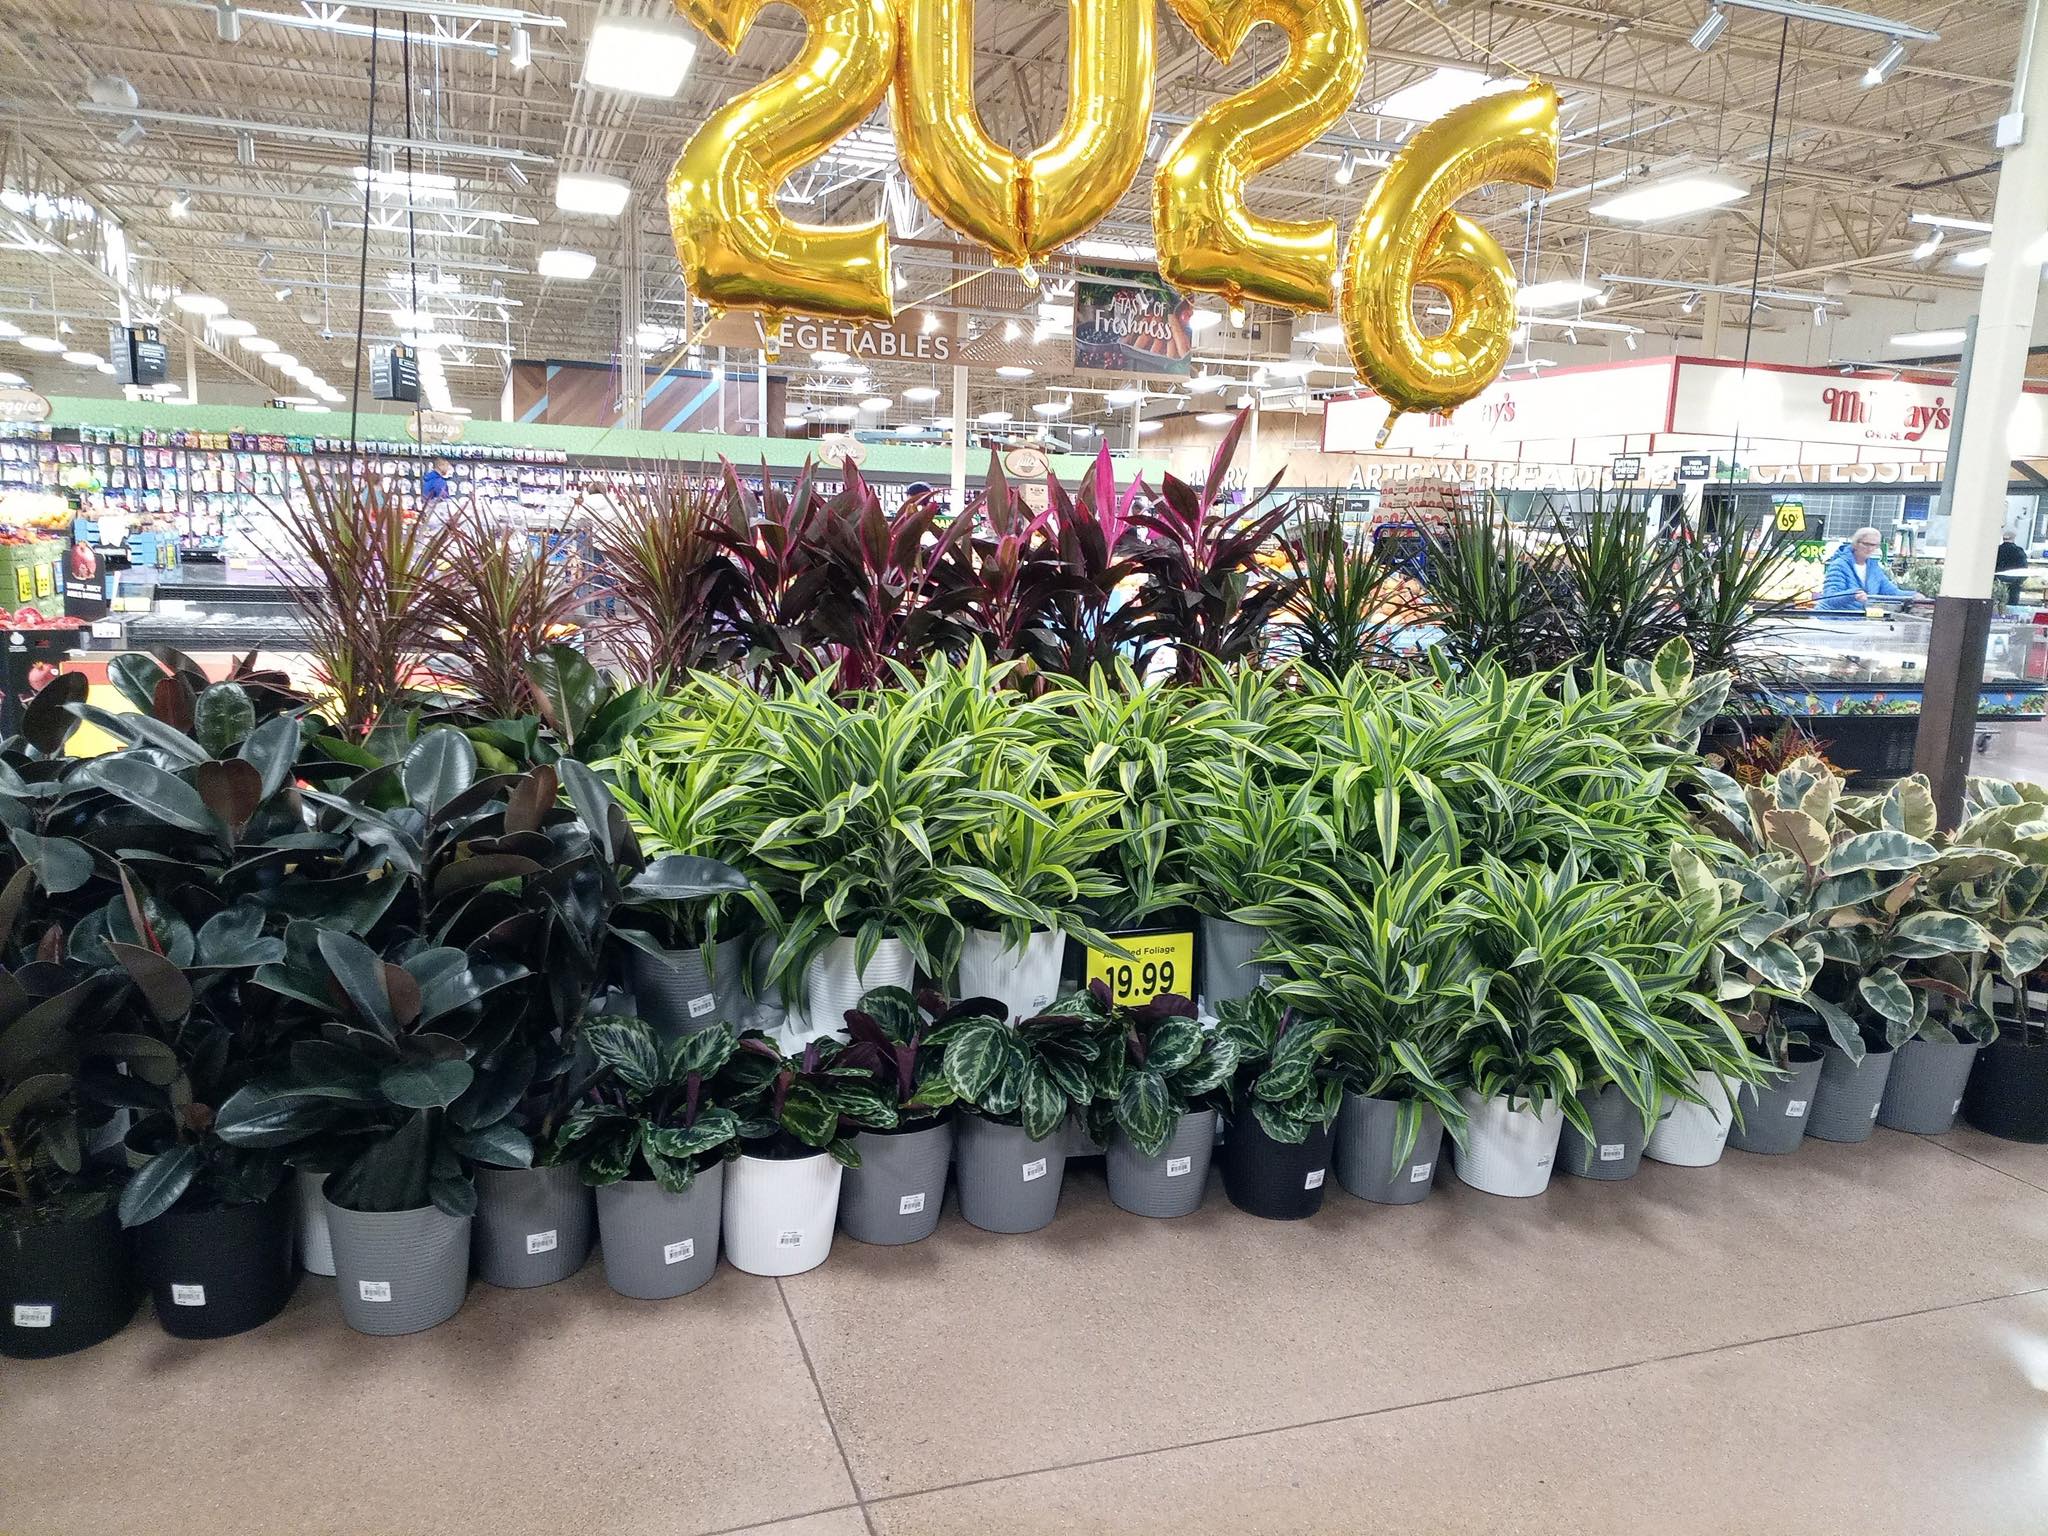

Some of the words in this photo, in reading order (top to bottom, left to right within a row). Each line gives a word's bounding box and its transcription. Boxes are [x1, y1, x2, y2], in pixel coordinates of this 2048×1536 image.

[1153, 302, 1167, 318] OF
[1095, 309, 1174, 340] Freshness
[146, 329, 158, 341] 12
[405, 347, 414, 359] 10
[1822, 387, 1951, 442] Muay's
[1143, 946, 1176, 955] Foliage
[1105, 960, 1175, 1000] 19.99
